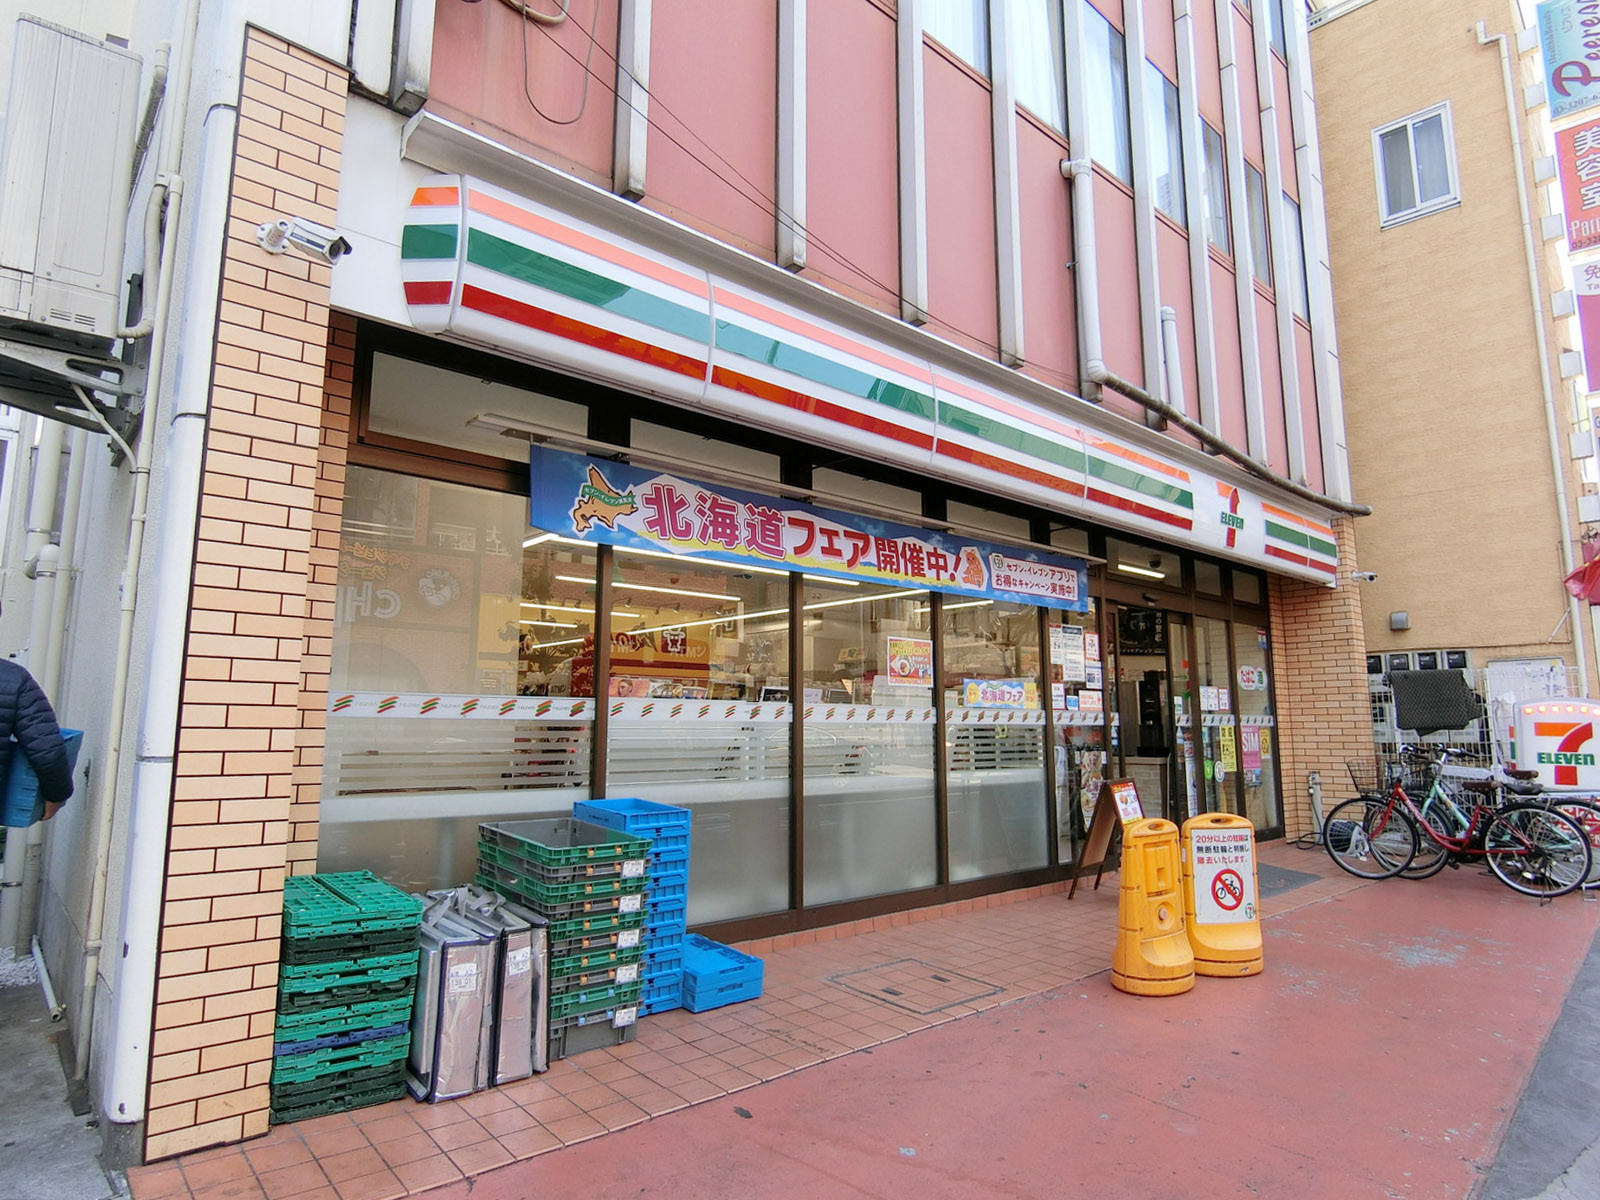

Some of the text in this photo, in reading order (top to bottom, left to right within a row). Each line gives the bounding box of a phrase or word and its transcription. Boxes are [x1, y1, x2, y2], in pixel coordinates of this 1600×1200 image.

[643, 483, 962, 582] 北海道フェア開催中!
[981, 688, 1023, 702] 北海道フェア
[1242, 732, 1259, 752] SIM
[1534, 722, 1593, 785] 7
